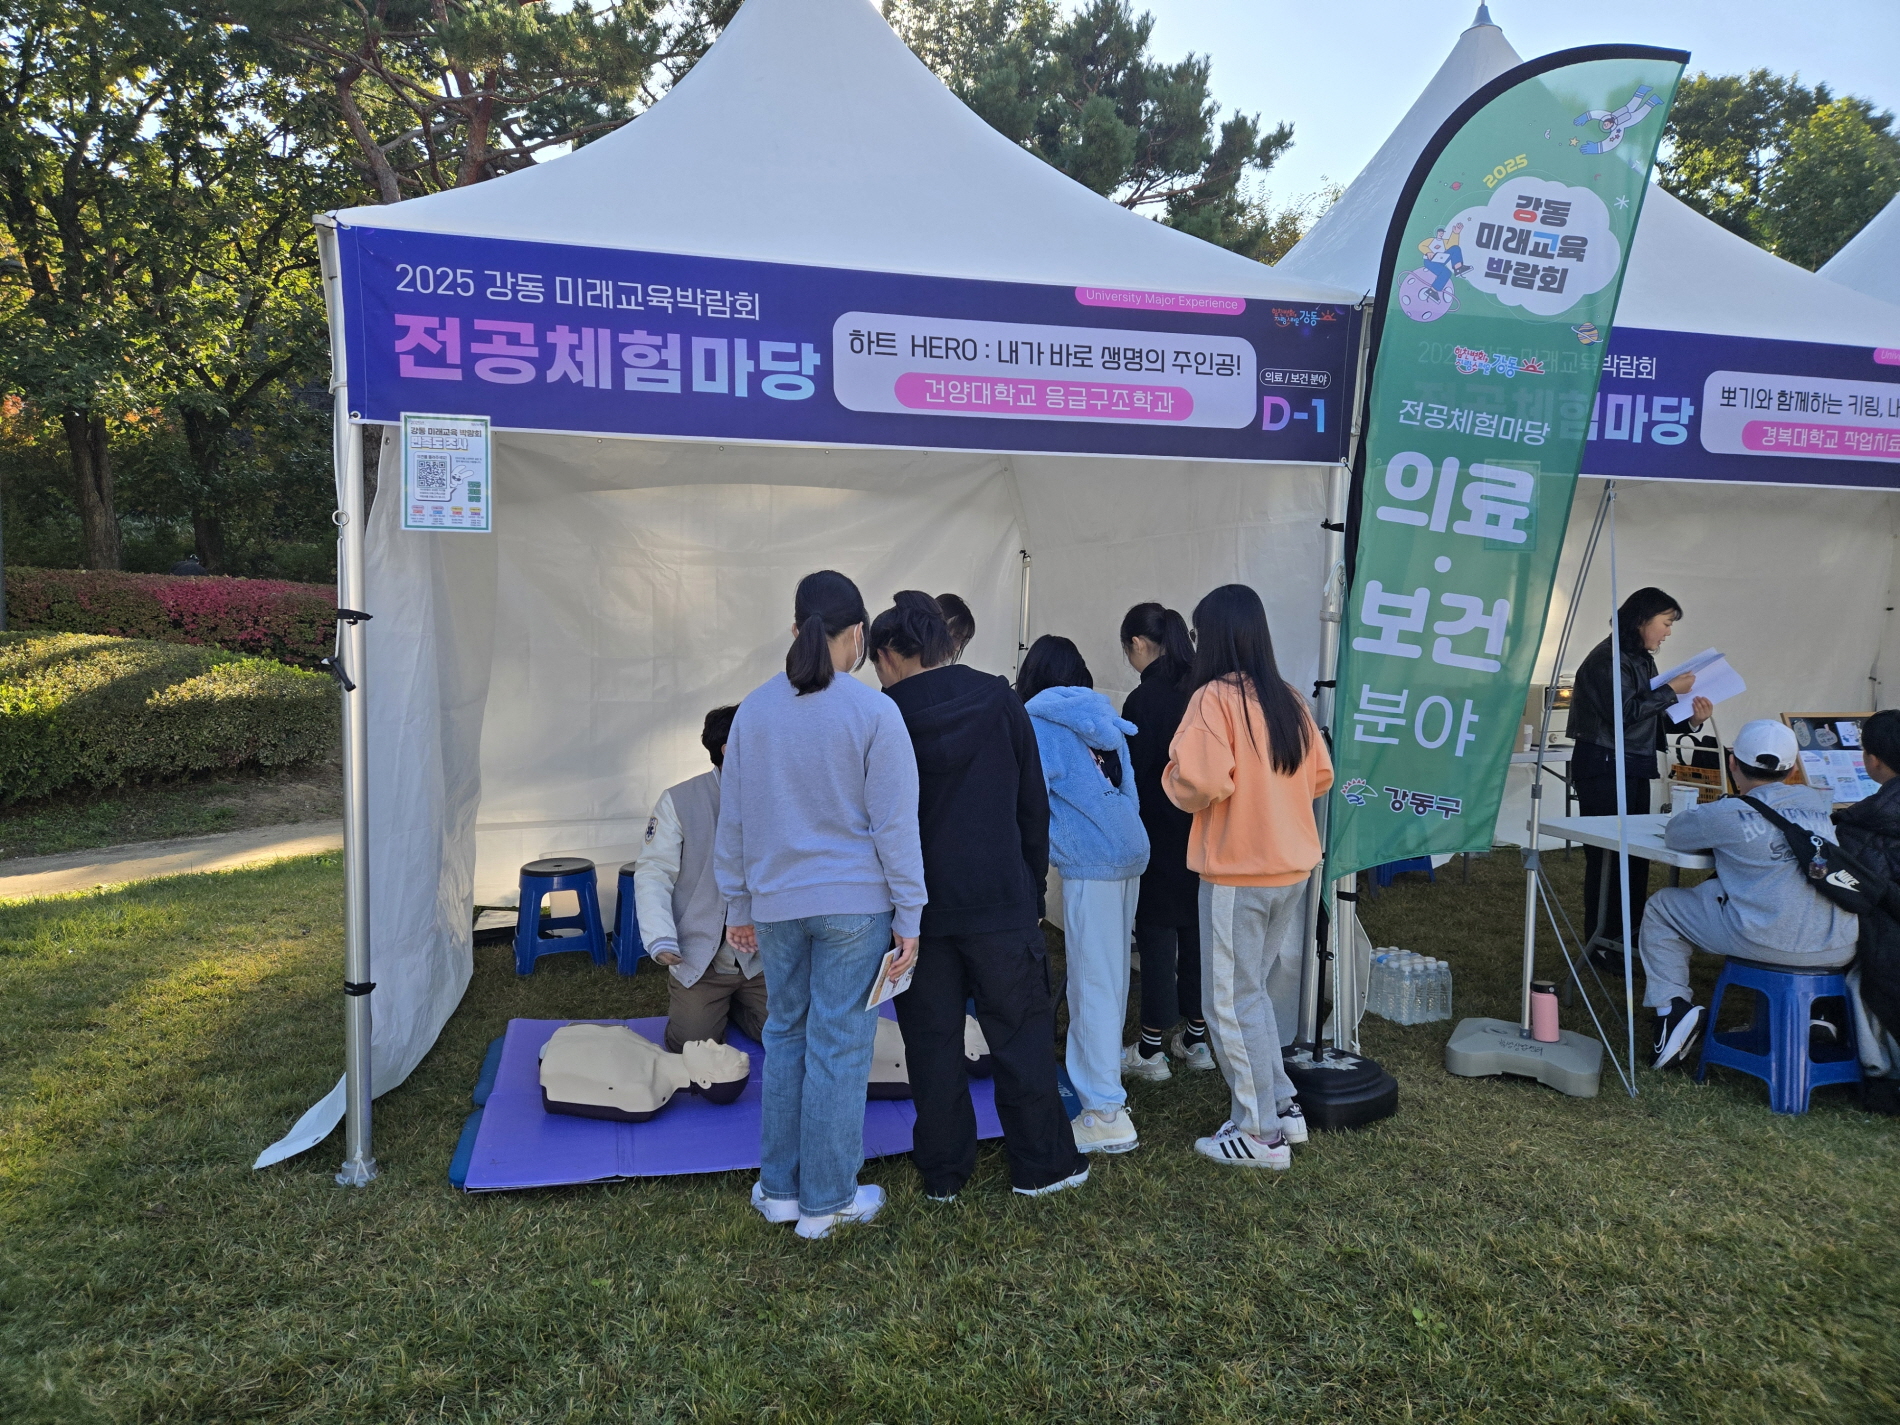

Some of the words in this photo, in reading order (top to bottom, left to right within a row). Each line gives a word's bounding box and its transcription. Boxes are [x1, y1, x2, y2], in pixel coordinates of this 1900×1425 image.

[1482, 153, 1528, 188] 2025
[1512, 194, 1571, 227] 강동
[1475, 221, 1588, 263] 미래교육
[395, 263, 475, 297] 2025
[484, 269, 544, 304] 강동
[556, 276, 761, 321] 미래교육박람회
[1484, 256, 1568, 294] 박람회
[1086, 289, 1141, 305] University
[1145, 294, 1175, 307] Major
[1179, 296, 1238, 310] Experience
[1299, 310, 1318, 326] 강동
[394, 313, 821, 402] 전공체험마당
[849, 328, 897, 357] 하트
[910, 336, 978, 361] HERO
[998, 340, 1045, 368] 내가
[1050, 344, 1094, 370] 바로
[1100, 345, 1165, 374] 생명의
[1171, 350, 1241, 377] 주인공!
[1491, 353, 1518, 378] 강동
[1264, 371, 1283, 383] 의료
[1290, 373, 1308, 385] 보건
[1310, 373, 1328, 386] 분야
[924, 379, 1036, 408] 건양대학교
[1045, 385, 1174, 415] 응급구조학과
[1262, 395, 1325, 433] D-1
[1777, 390, 1843, 415] 함께하는
[1848, 394, 1883, 418] 키링,
[410, 426, 426, 435] 강동
[427, 427, 458, 437] 미래교육
[1398, 399, 1551, 446] 전공체험마당
[1762, 426, 1839, 449] 경복대학교
[1376, 451, 1535, 544] 의료
[1352, 579, 1511, 673] 보건
[1353, 683, 1479, 757] 분야
[1383, 785, 1462, 820] 강동구
[1835, 869, 1860, 886] NIKE
